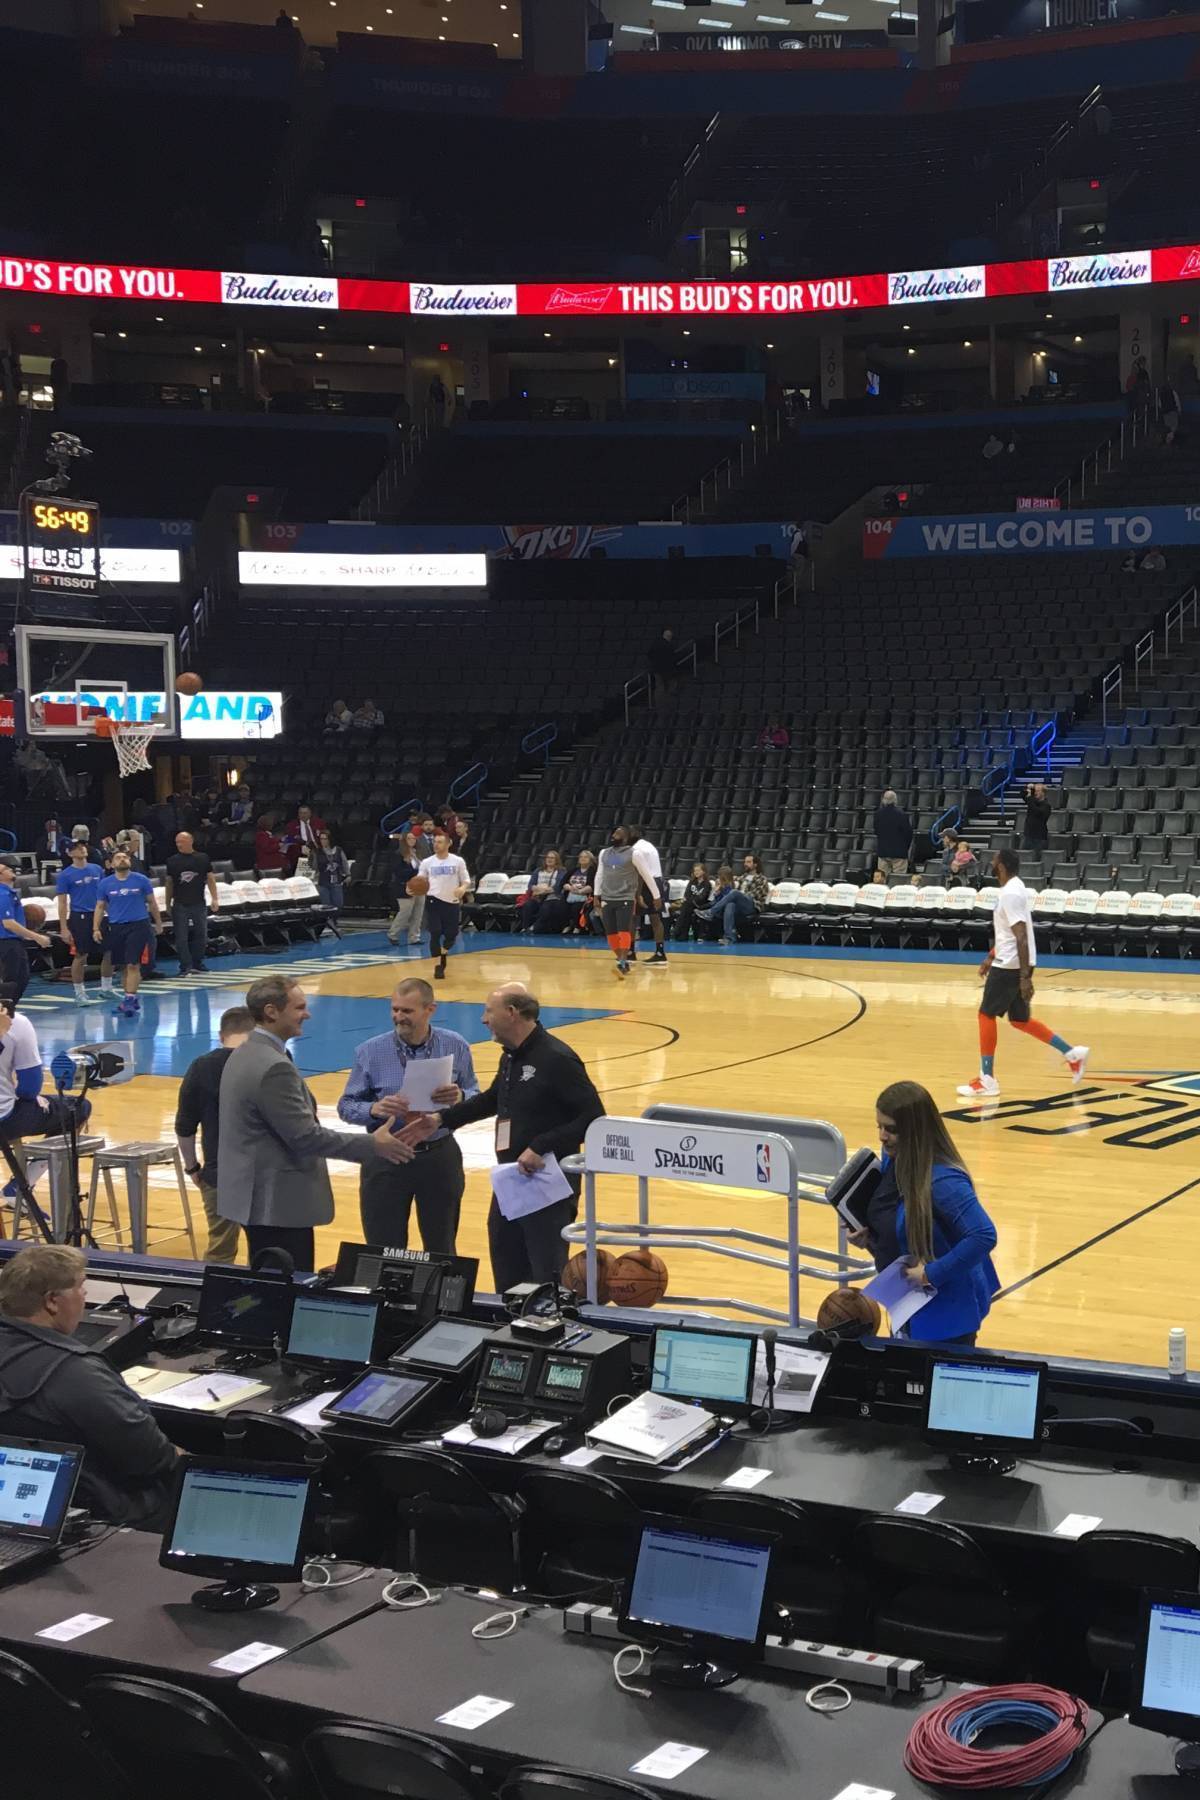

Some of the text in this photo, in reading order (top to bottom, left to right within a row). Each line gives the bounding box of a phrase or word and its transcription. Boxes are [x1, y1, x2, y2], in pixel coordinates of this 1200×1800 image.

[58, 264, 113, 294] FOR
[119, 269, 185, 298] YOU.
[889, 272, 983, 302] Budweiser
[1051, 258, 1148, 288] Budweiser
[224, 273, 335, 304] Budweiser
[413, 284, 514, 312] Budweiser
[618, 285, 674, 312] THIS
[679, 284, 753, 311] BUD'S
[758, 284, 804, 310] FOR
[807, 280, 859, 307] YOU.
[34, 505, 89, 533] 56:49
[159, 522, 193, 536] 102
[265, 525, 297, 538] 103
[864, 520, 893, 535] 104
[922, 516, 1153, 551] WELCOME TO
[51, 575, 97, 589] TISSOT
[183, 694, 274, 721] AND
[602, 1147, 635, 1162] GAME BALL
[605, 1134, 631, 1149] OFFICIAL
[655, 1148, 724, 1176] SPALDING
[382, 1247, 430, 1262] SAMSUNG
